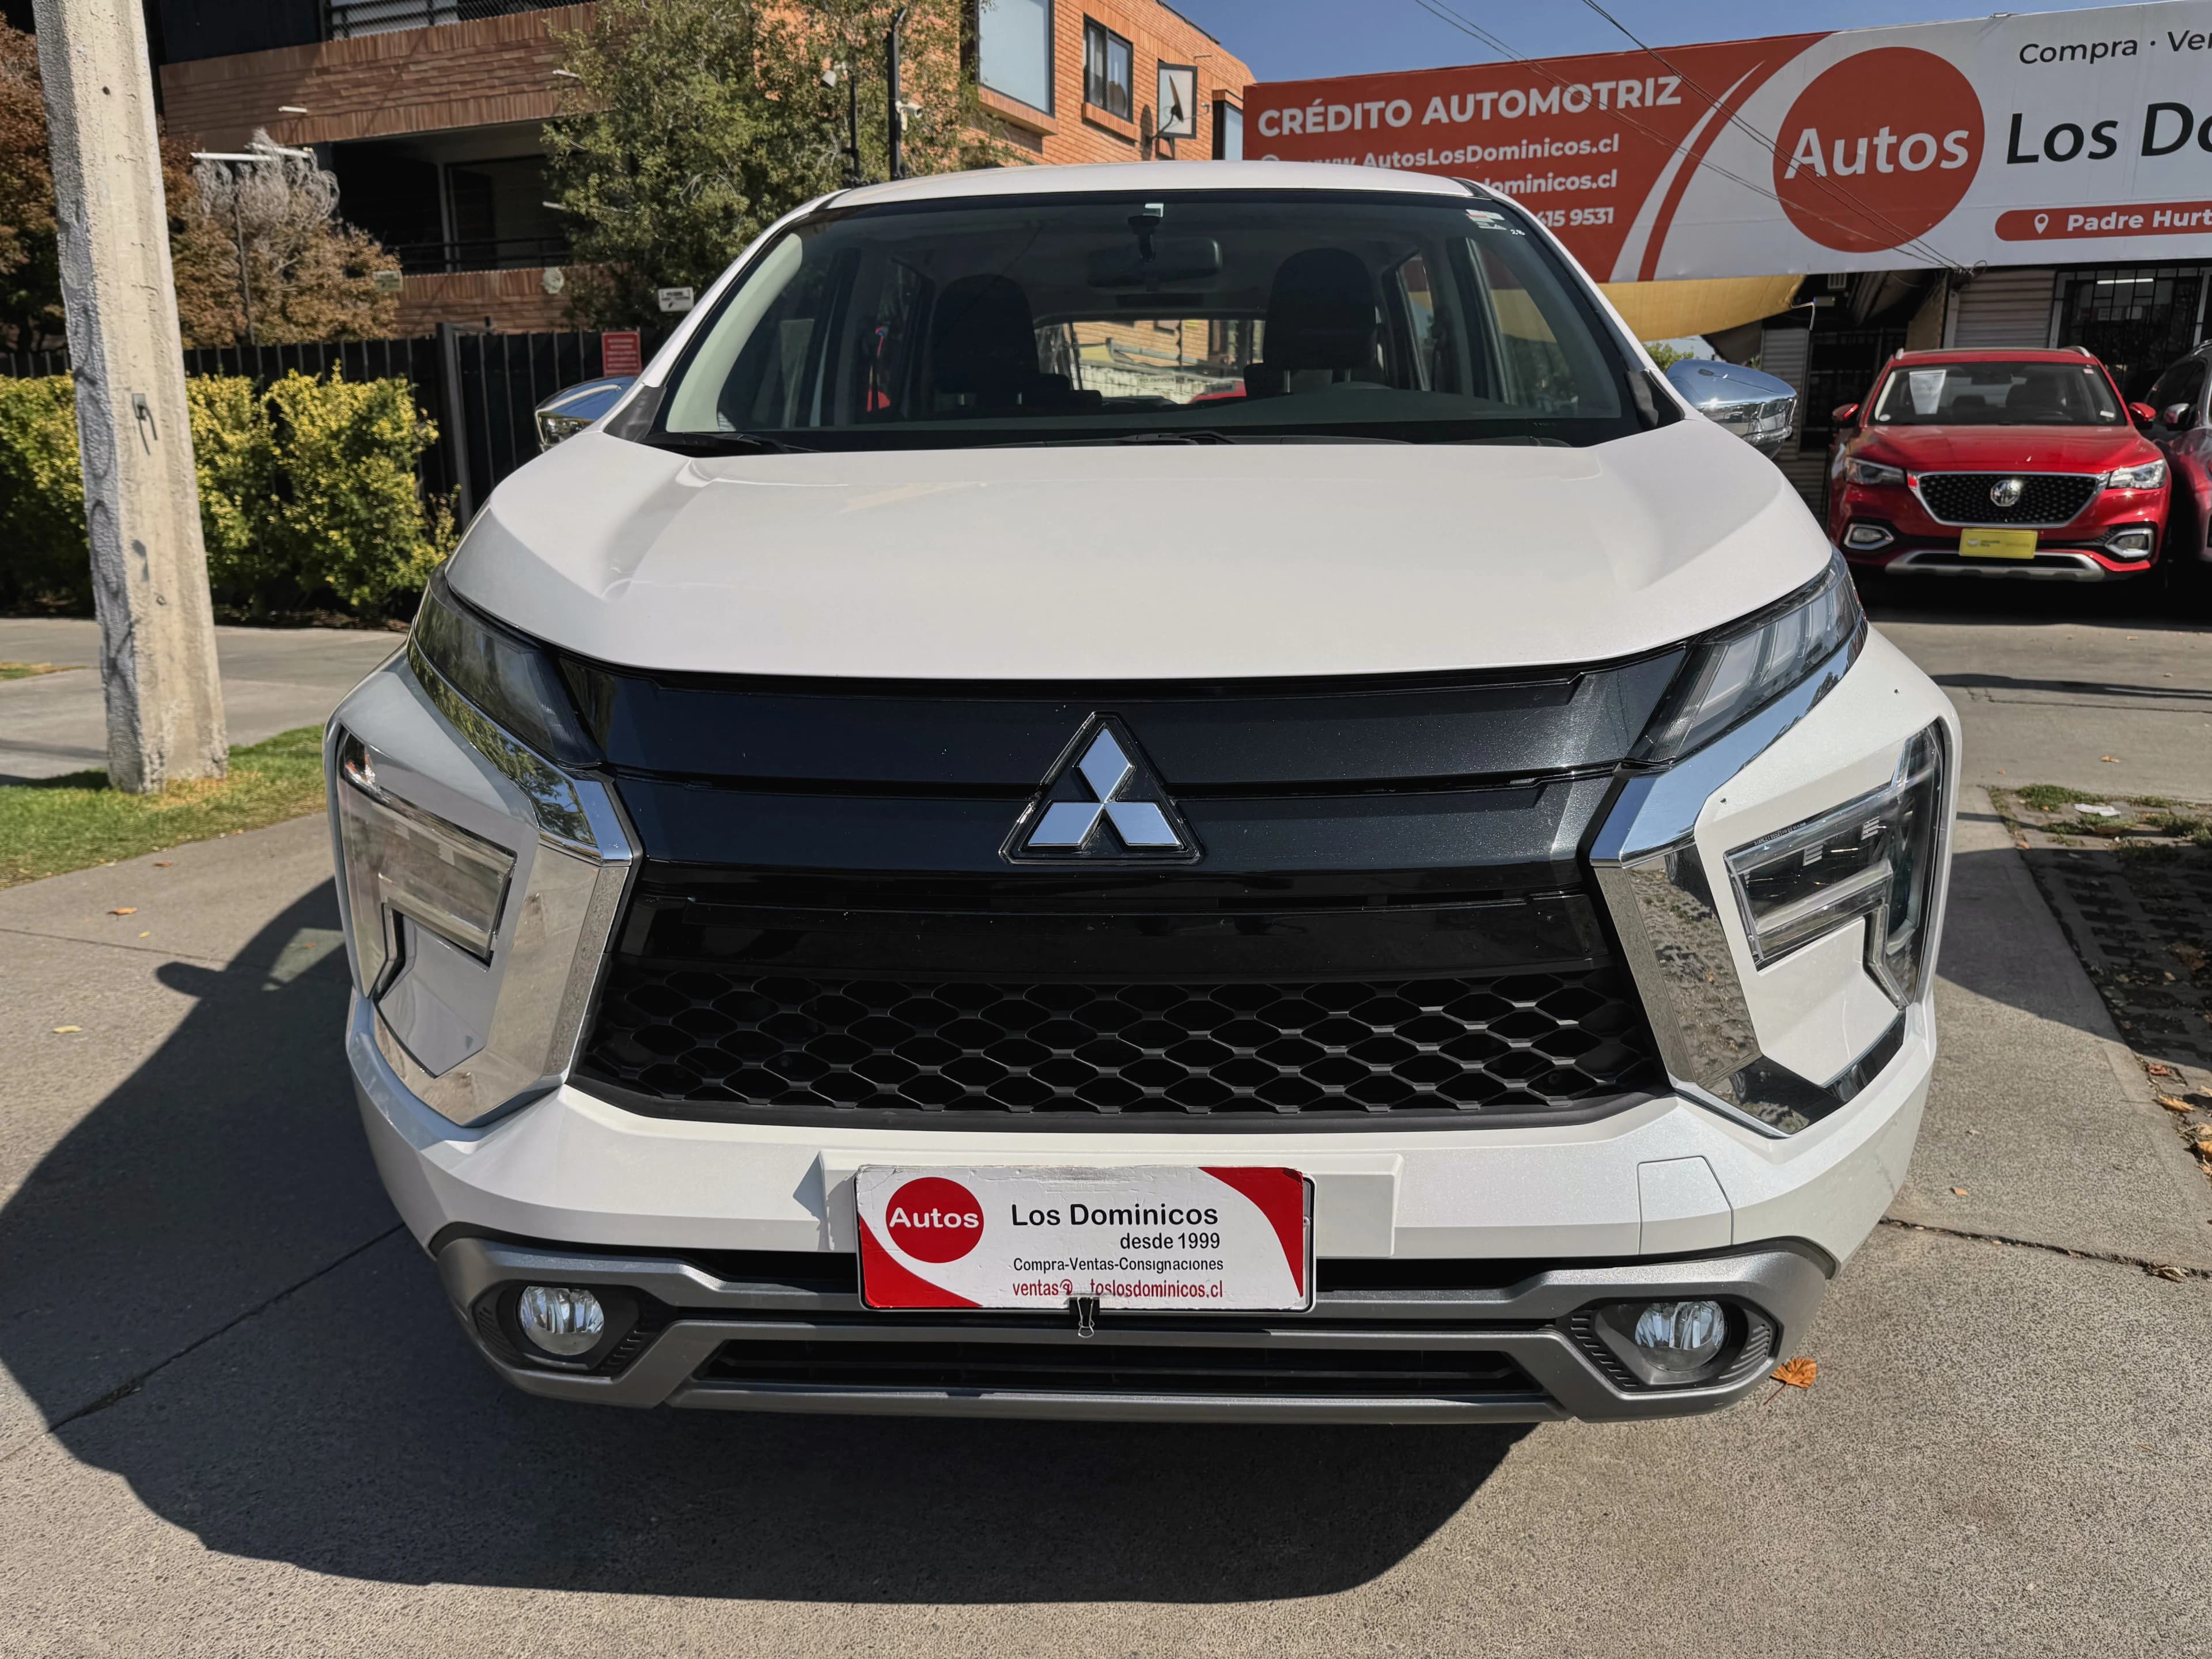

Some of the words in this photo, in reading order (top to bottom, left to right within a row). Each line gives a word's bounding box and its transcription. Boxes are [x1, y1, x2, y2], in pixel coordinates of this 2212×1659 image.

[2019, 39, 2138, 65] Compra
[1258, 99, 1412, 137] CRÉDITO
[1422, 75, 1682, 125] AUTOMOTRIZ
[2006, 113, 2119, 165] Los
[1784, 126, 1969, 180] Autos
[1569, 207, 1615, 226] 9531
[2067, 211, 2144, 232] Padre
[2153, 209, 2212, 228] Hurt
[889, 1206, 980, 1229] Autos
[1012, 1204, 1061, 1226] Los
[1070, 1203, 1218, 1226] Dominicos
[1120, 1232, 1173, 1249] desde
[1178, 1232, 1221, 1250] 1999
[1013, 1257, 1224, 1274] Compra-Ventas-Consignaciones
[1012, 1278, 1223, 1297] ventas@toslosdominicos.cl
